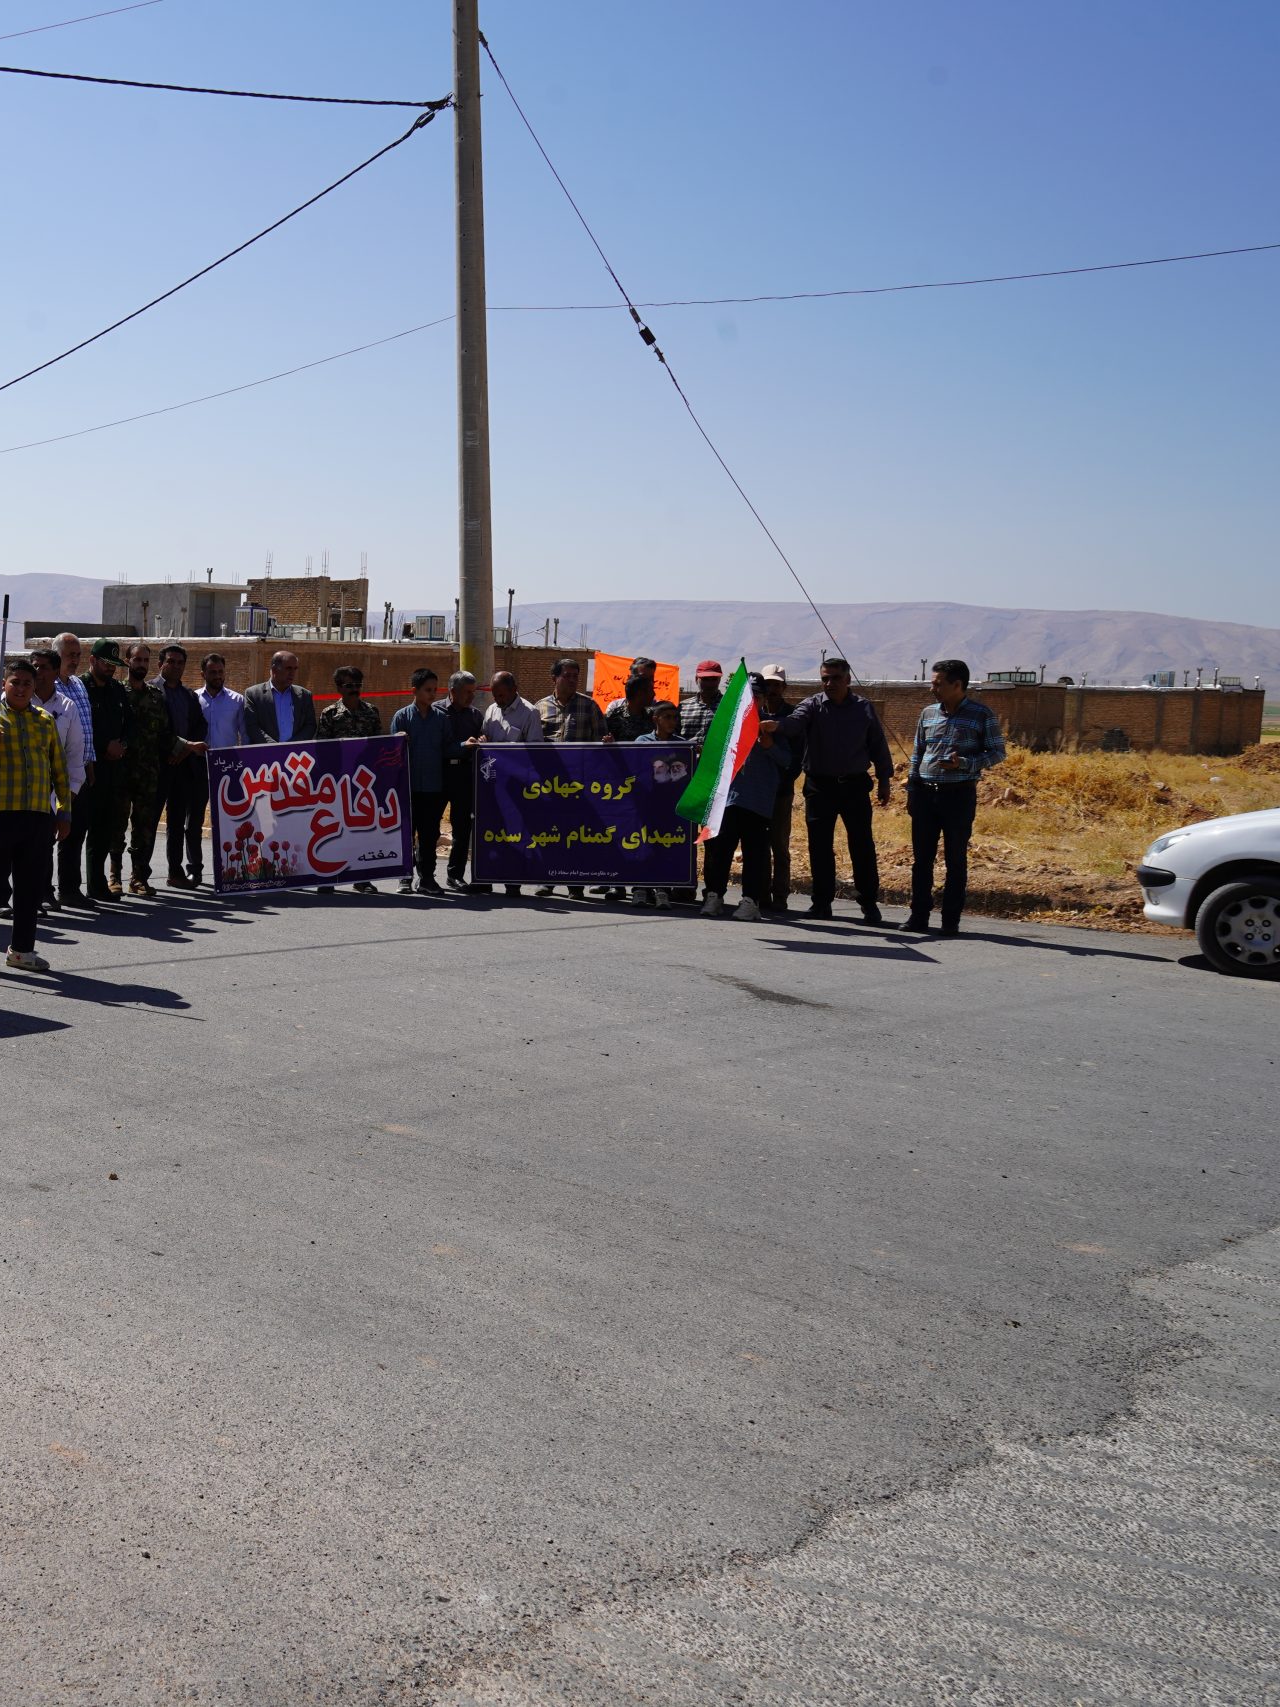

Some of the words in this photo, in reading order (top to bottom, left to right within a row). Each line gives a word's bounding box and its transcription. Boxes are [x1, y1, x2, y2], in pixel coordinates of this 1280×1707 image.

[218, 751, 338, 820] مقدس
[522, 775, 585, 800] جهادی
[589, 775, 637, 800] گروه
[306, 764, 401, 877] دفاع
[483, 827, 522, 843] سده
[526, 825, 562, 849] شهر
[566, 825, 617, 848] گمنام
[621, 825, 687, 850] شهدای
[357, 850, 398, 862] هفته
